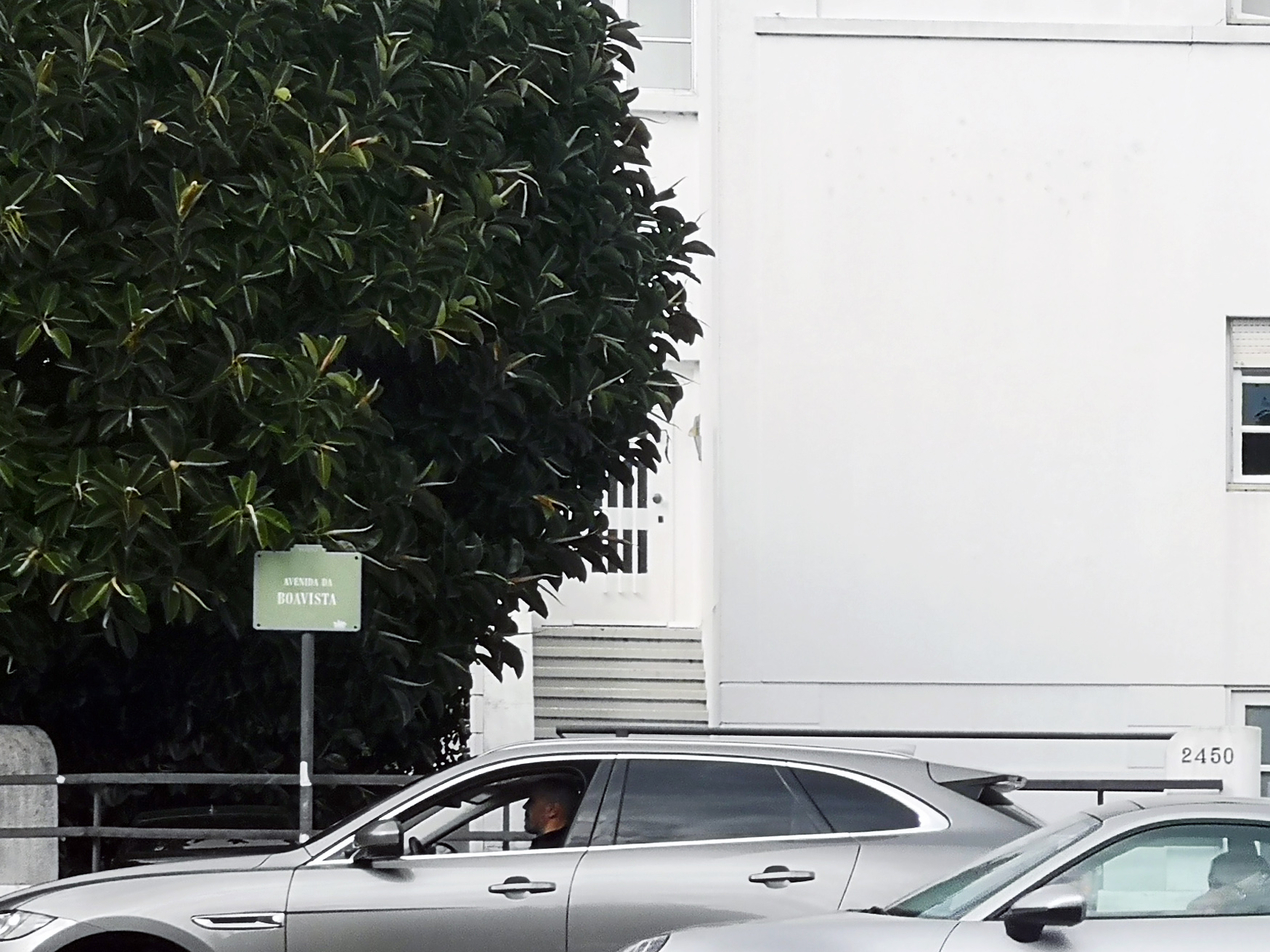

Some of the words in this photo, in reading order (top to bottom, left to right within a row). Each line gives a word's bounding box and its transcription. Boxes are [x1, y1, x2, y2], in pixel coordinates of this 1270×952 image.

[284, 577, 319, 587] AVENIDA
[321, 578, 333, 587] DA
[277, 591, 337, 606] BOAVISTA
[1181, 747, 1234, 765] 2450
